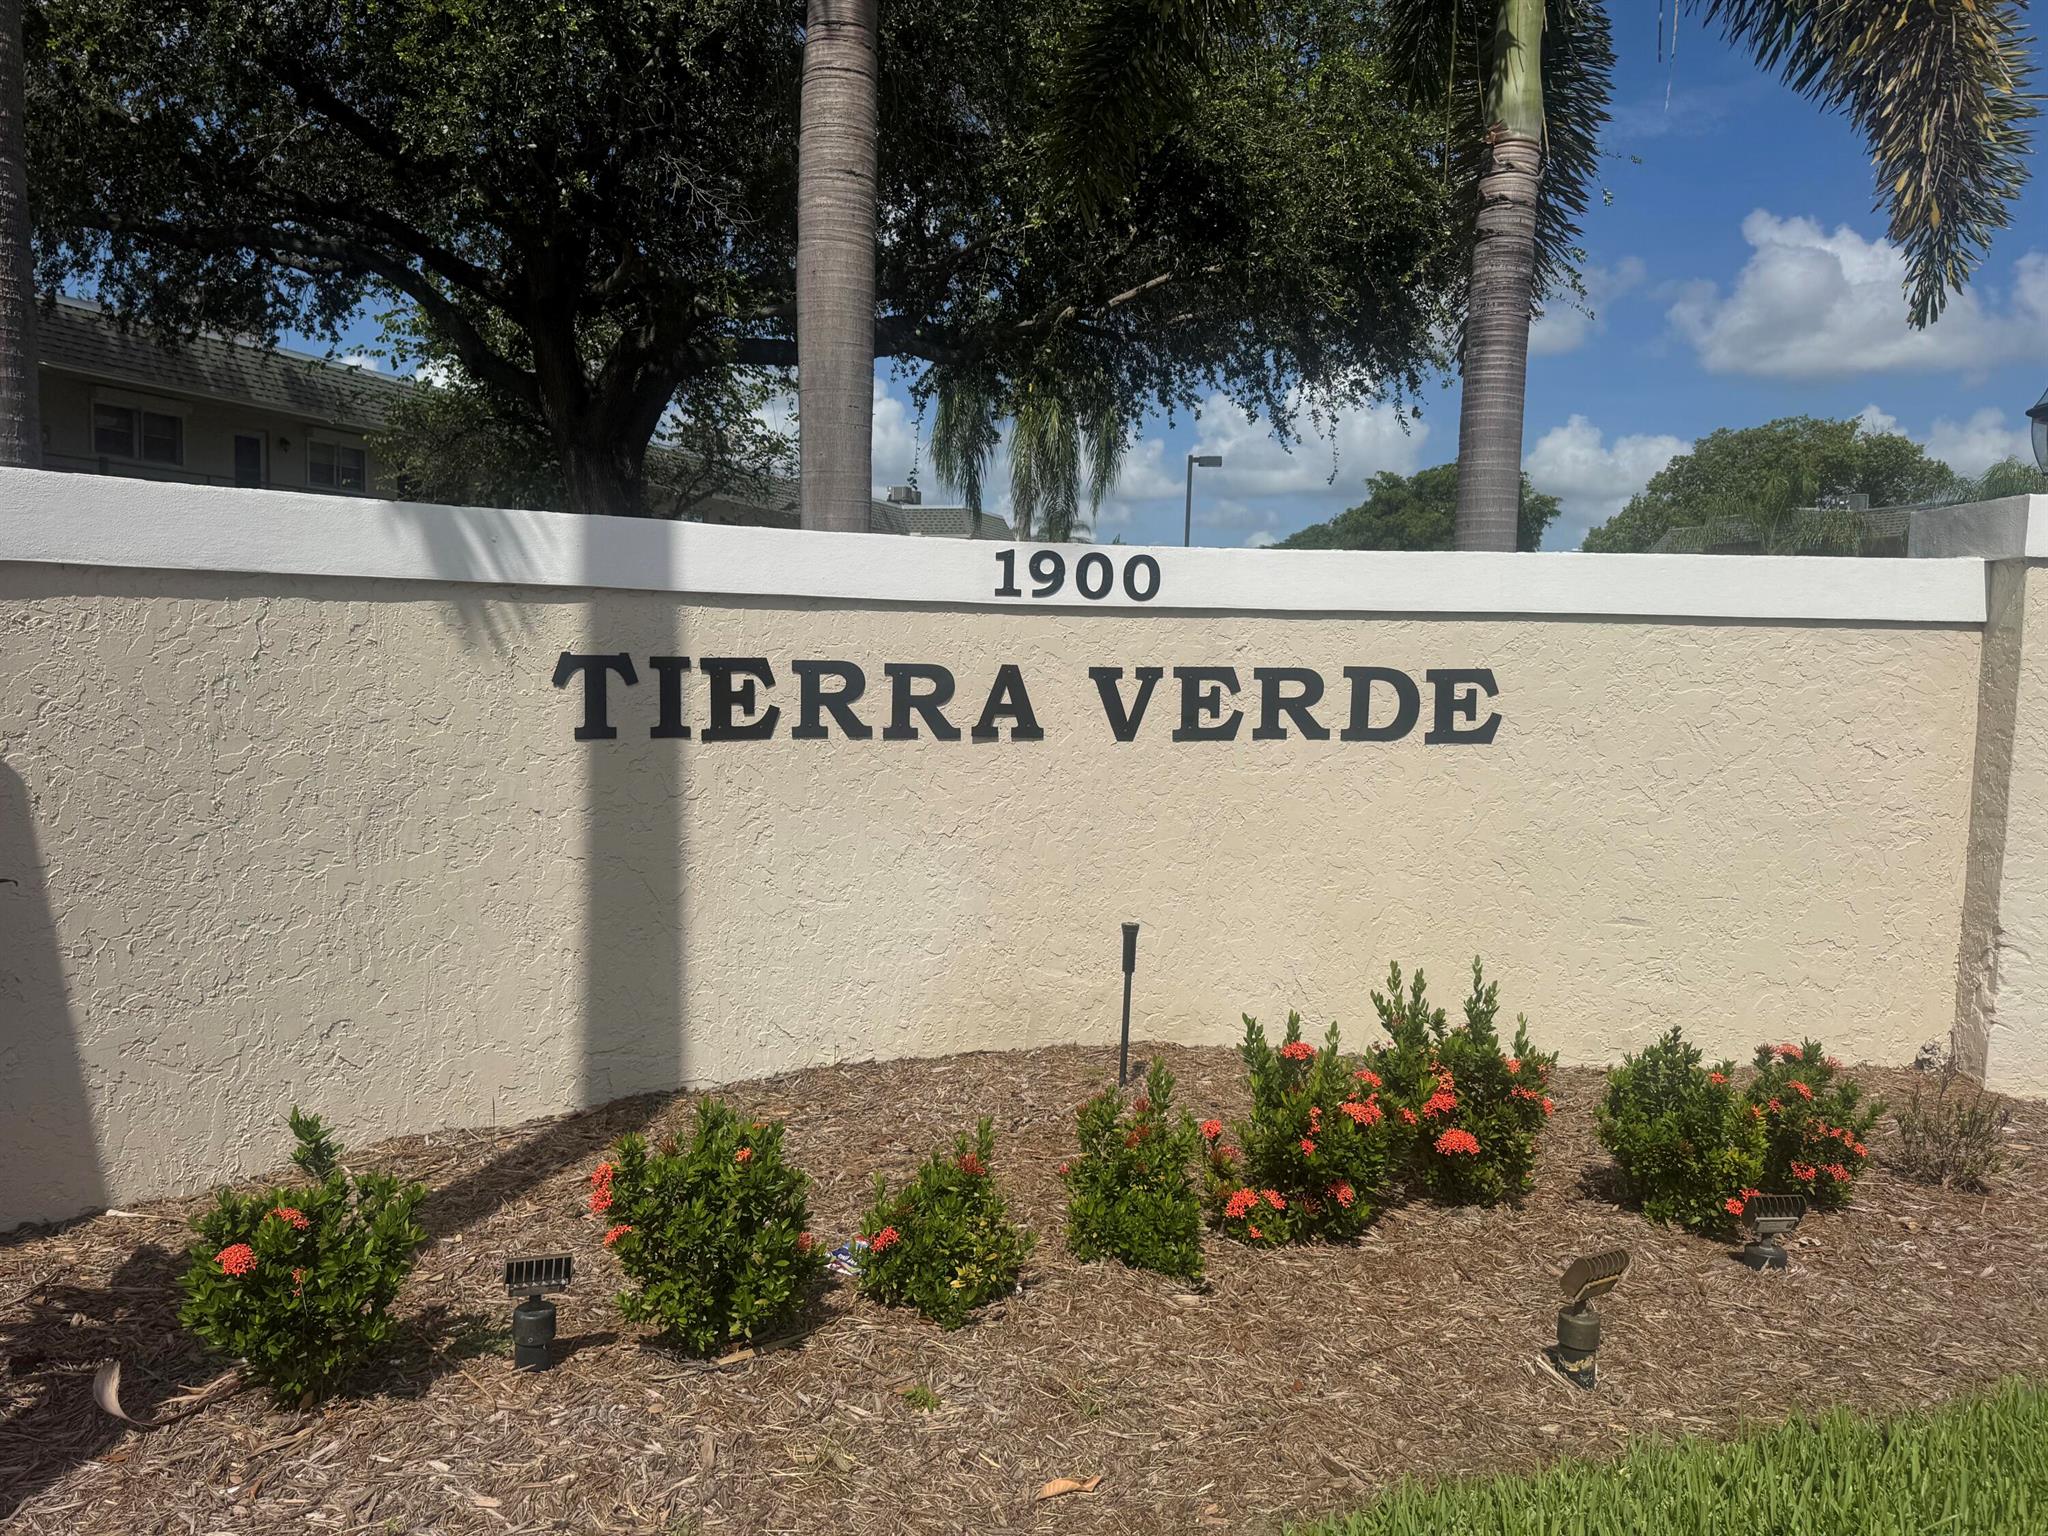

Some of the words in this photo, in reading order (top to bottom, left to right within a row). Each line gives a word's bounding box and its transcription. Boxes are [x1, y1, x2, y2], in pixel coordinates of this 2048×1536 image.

[994, 549, 1162, 603] 1900
[552, 651, 1044, 743] TIERRA
[1089, 666, 1502, 745] VERDE
